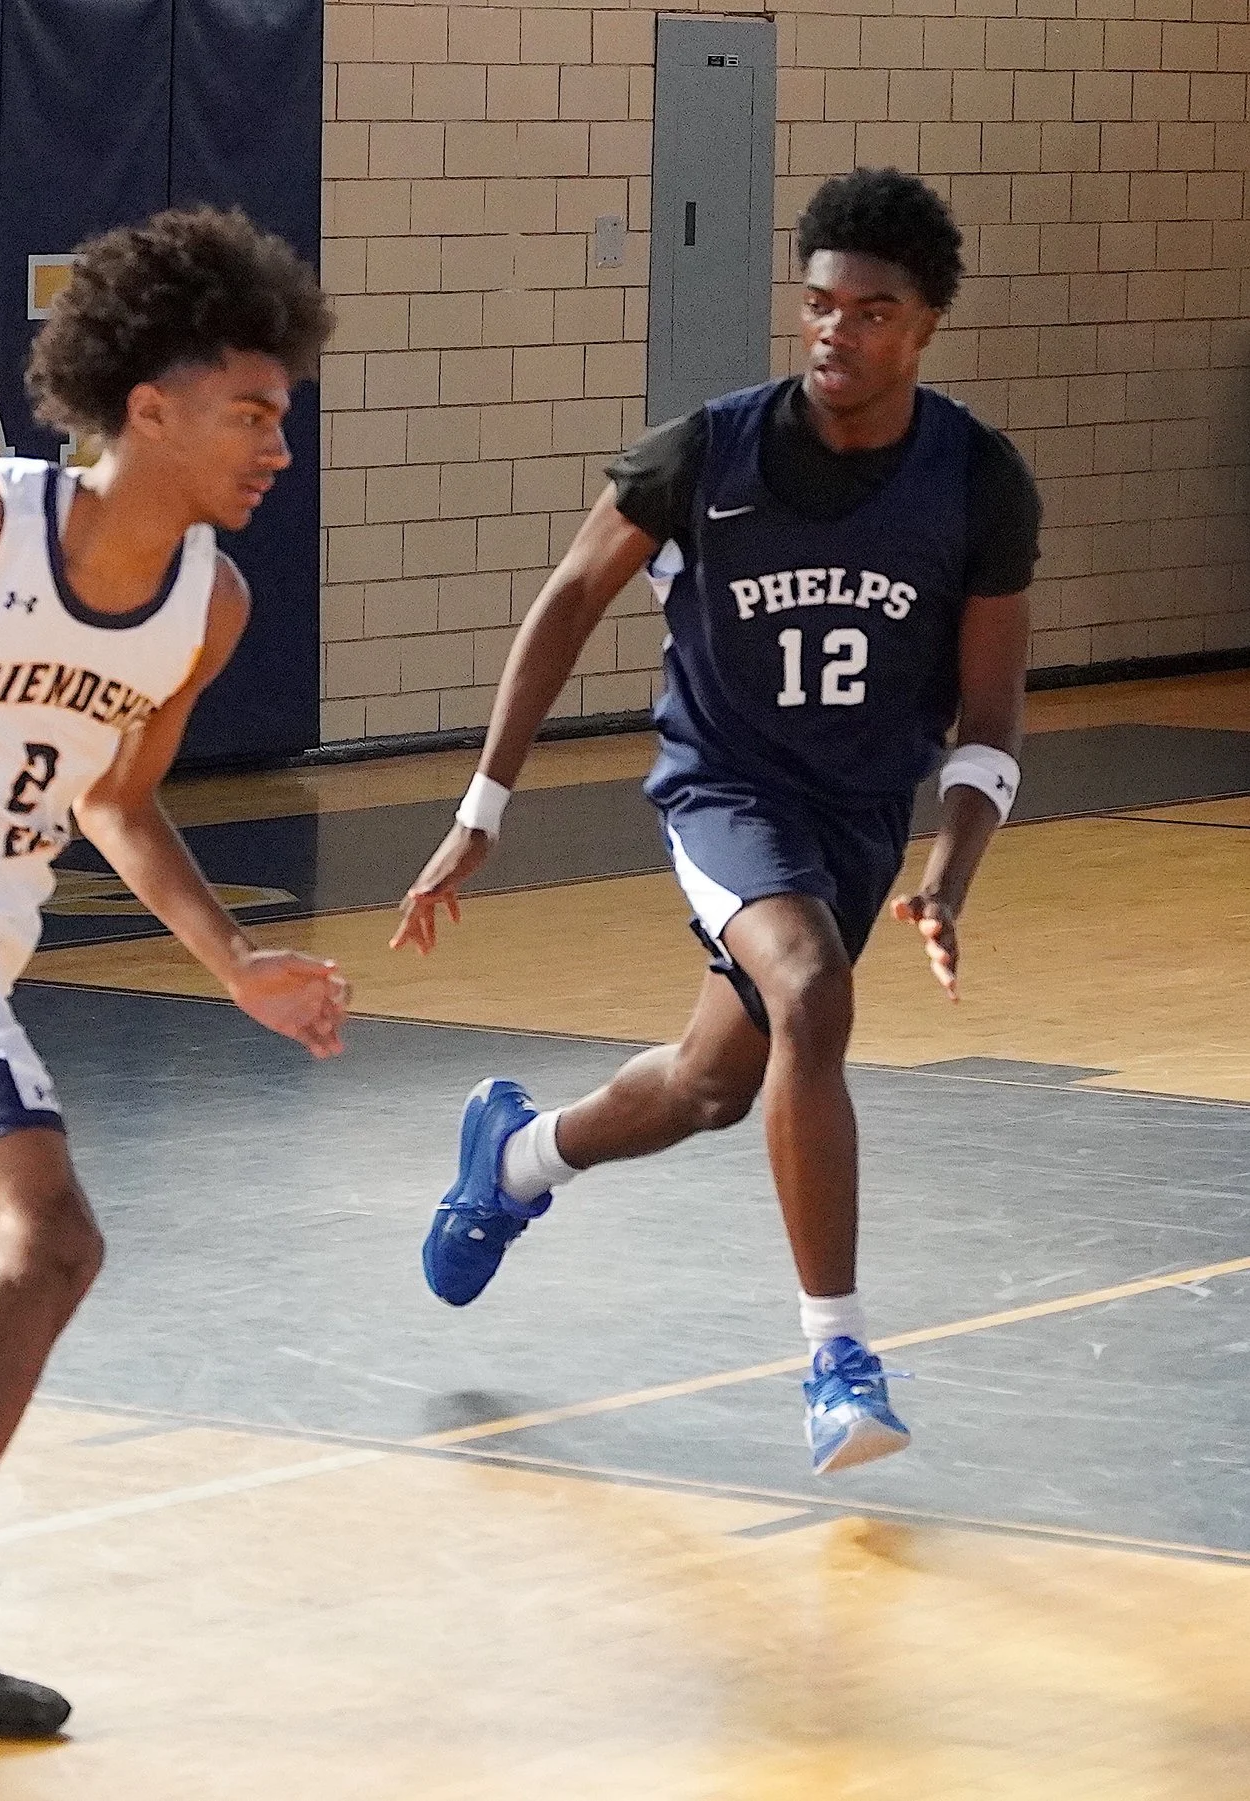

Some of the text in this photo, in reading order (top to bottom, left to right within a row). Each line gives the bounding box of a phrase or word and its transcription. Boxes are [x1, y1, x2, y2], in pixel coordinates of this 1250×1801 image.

[728, 567, 918, 621] PHELPS
[776, 627, 869, 708] 12
[3, 741, 60, 815] 2
